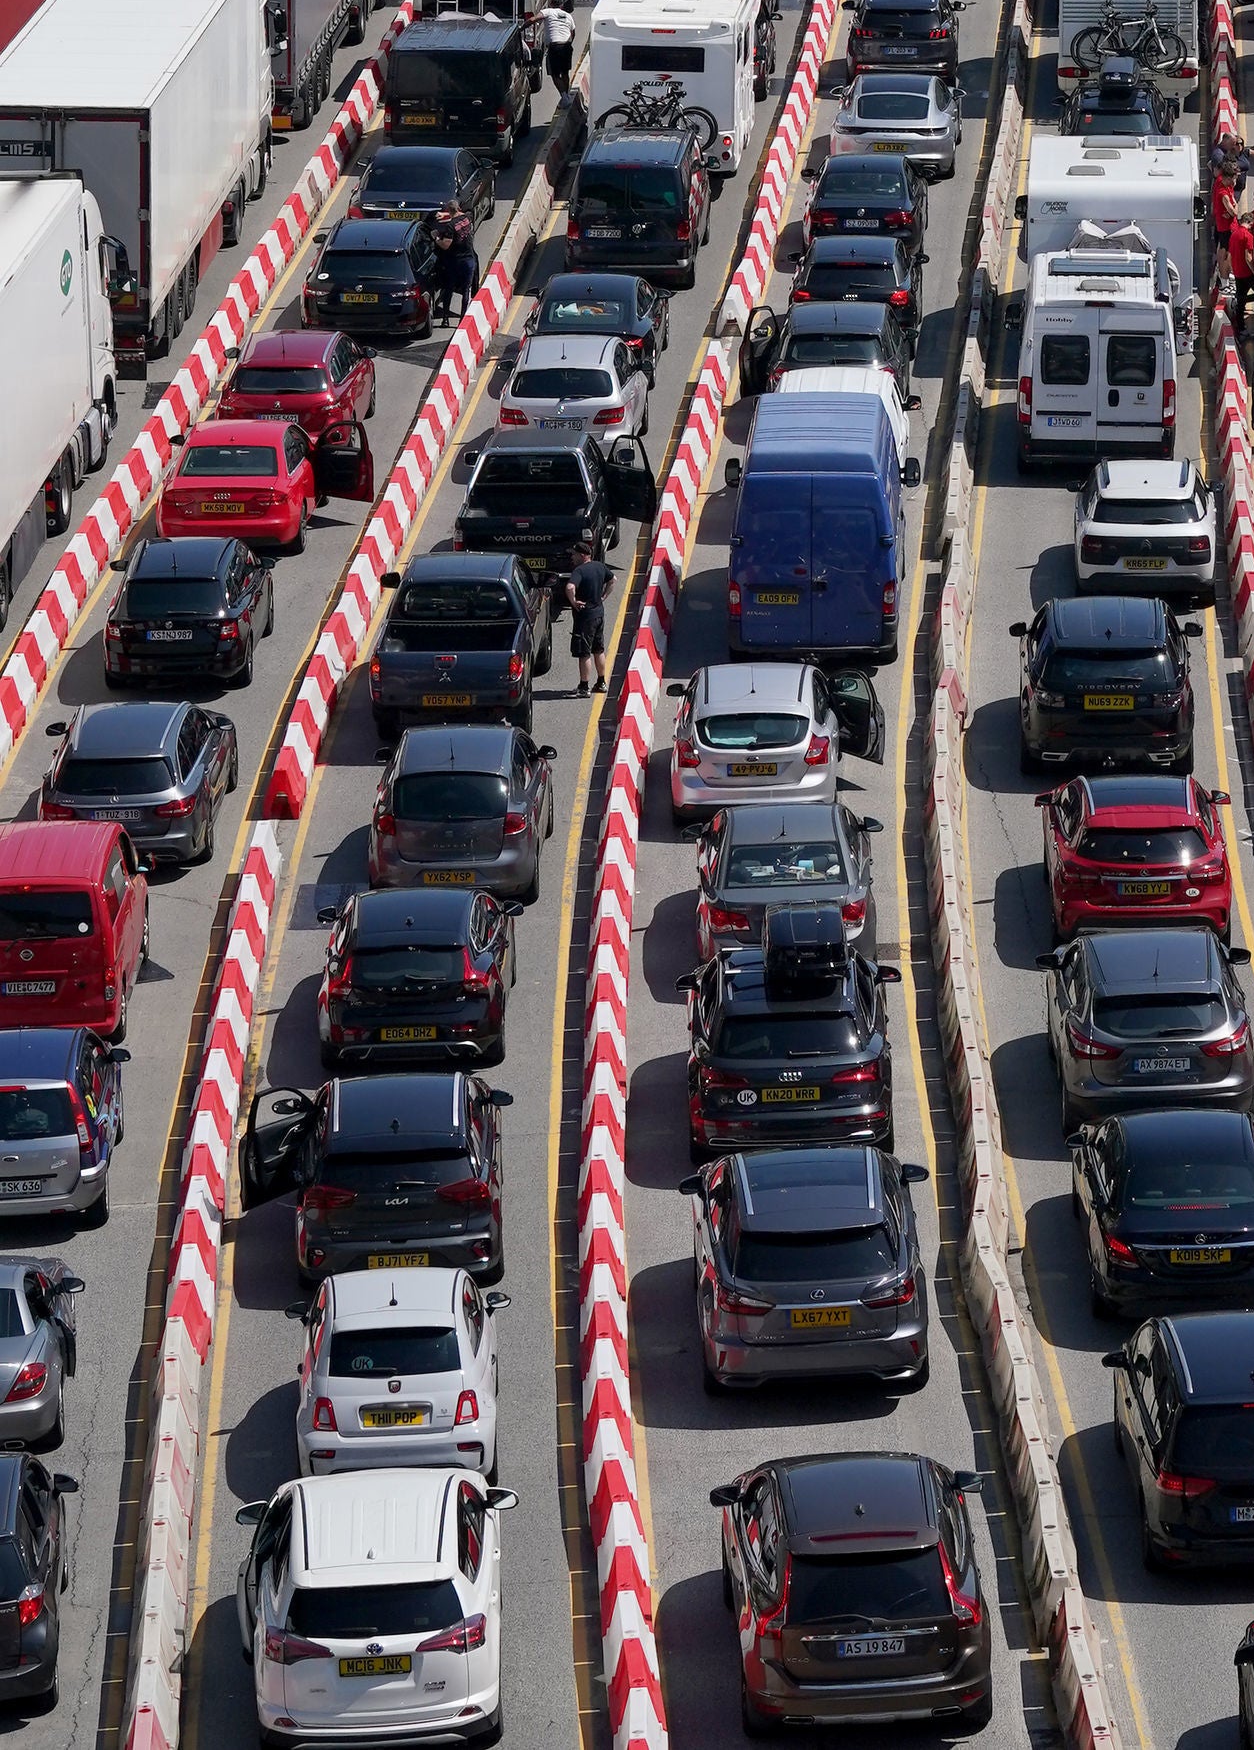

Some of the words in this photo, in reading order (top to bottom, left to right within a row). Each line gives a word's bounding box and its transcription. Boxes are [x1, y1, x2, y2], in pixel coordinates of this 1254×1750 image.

[1126, 560, 1145, 569] KR65
[1146, 559, 1165, 568] FLP
[757, 594, 778, 603] EA09
[781, 594, 798, 603] OFN
[1087, 697, 1112, 707] NU69
[1113, 697, 1131, 707] ZZK
[95, 810, 140, 819] 1-TUZ-918
[427, 873, 452, 882] YX62
[453, 872, 472, 881] YSP
[1123, 884, 1148, 894] KW68
[1150, 883, 1170, 893] YYJ
[7, 983, 24, 993] VIE
[385, 1028, 408, 1039] EO64
[410, 1027, 432, 1038] DHZ
[1139, 1060, 1153, 1070] AX
[1153, 1058, 1173, 1069] 9874
[1174, 1057, 1187, 1068] ET
[741, 1092, 755, 1103] UK
[766, 1089, 792, 1100] KN20
[795, 1087, 815, 1098] WRR
[7, 1181, 21, 1192] SK
[22, 1180, 40, 1192] 636
[377, 1255, 402, 1268] BJ71
[404, 1254, 425, 1266] YFZ
[1176, 1250, 1201, 1261] KO19
[1203, 1250, 1224, 1260] SKF
[793, 1313, 822, 1324] LX67
[825, 1311, 848, 1323] YXT
[353, 1357, 370, 1370] UK
[394, 1412, 417, 1424] POP
[1236, 1509, 1245, 1519] M
[845, 1642, 861, 1654] AS
[865, 1641, 879, 1653] 19
[881, 1639, 904, 1652] 847
[346, 1658, 375, 1672] MC16
[377, 1657, 403, 1671] JNK
